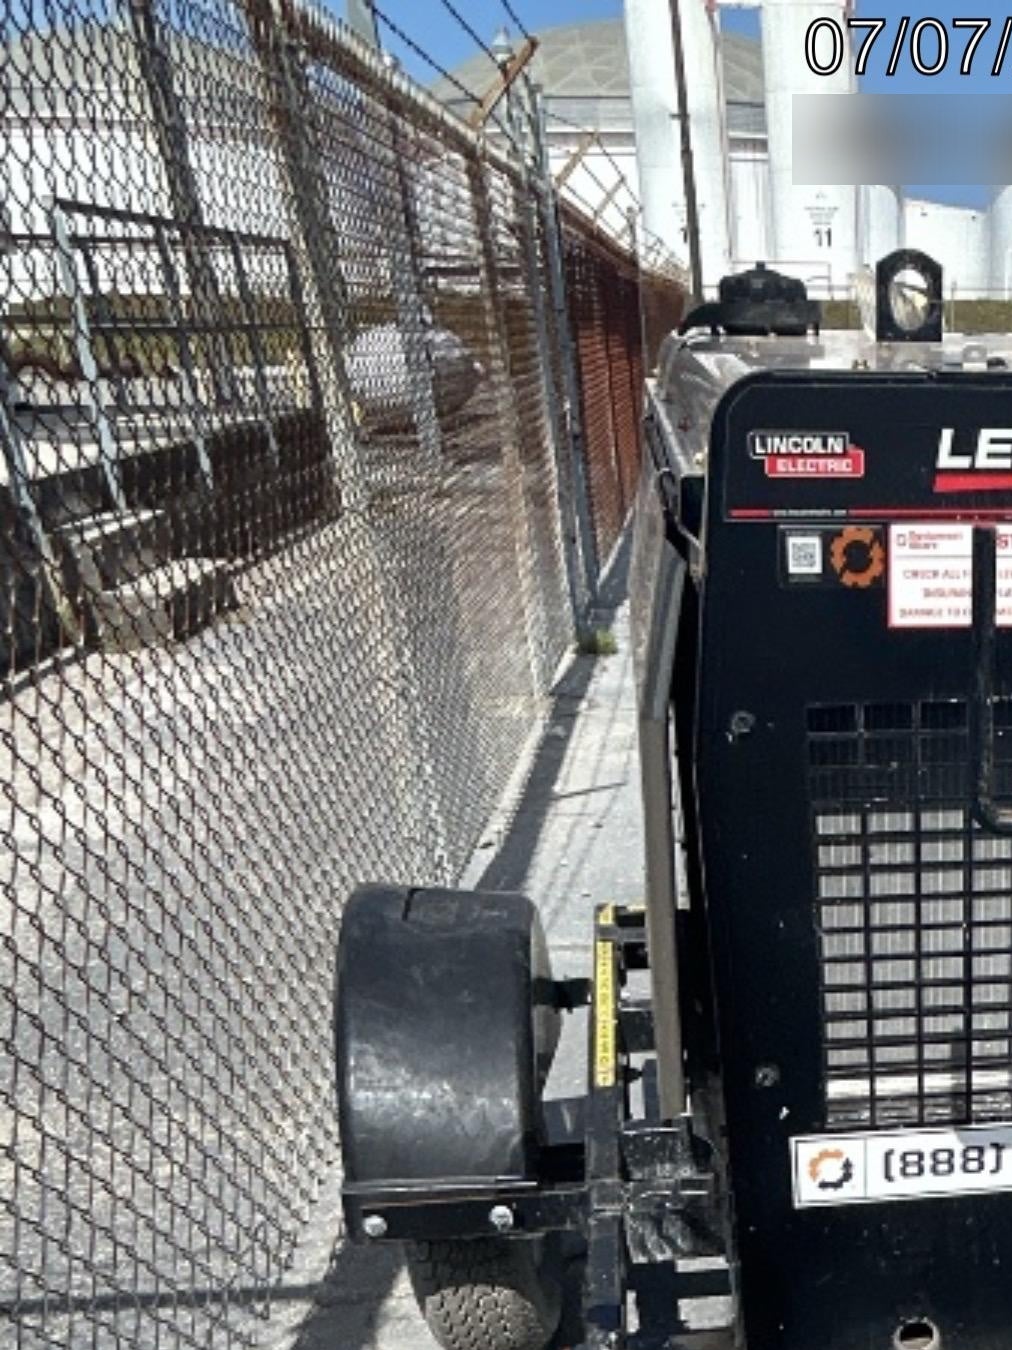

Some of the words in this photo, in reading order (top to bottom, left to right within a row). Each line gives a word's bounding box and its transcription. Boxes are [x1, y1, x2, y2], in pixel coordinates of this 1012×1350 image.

[754, 436, 844, 455] LINCOLN
[775, 458, 853, 473] ELECTRIC
[883, 1142, 1004, 1183] (888)
